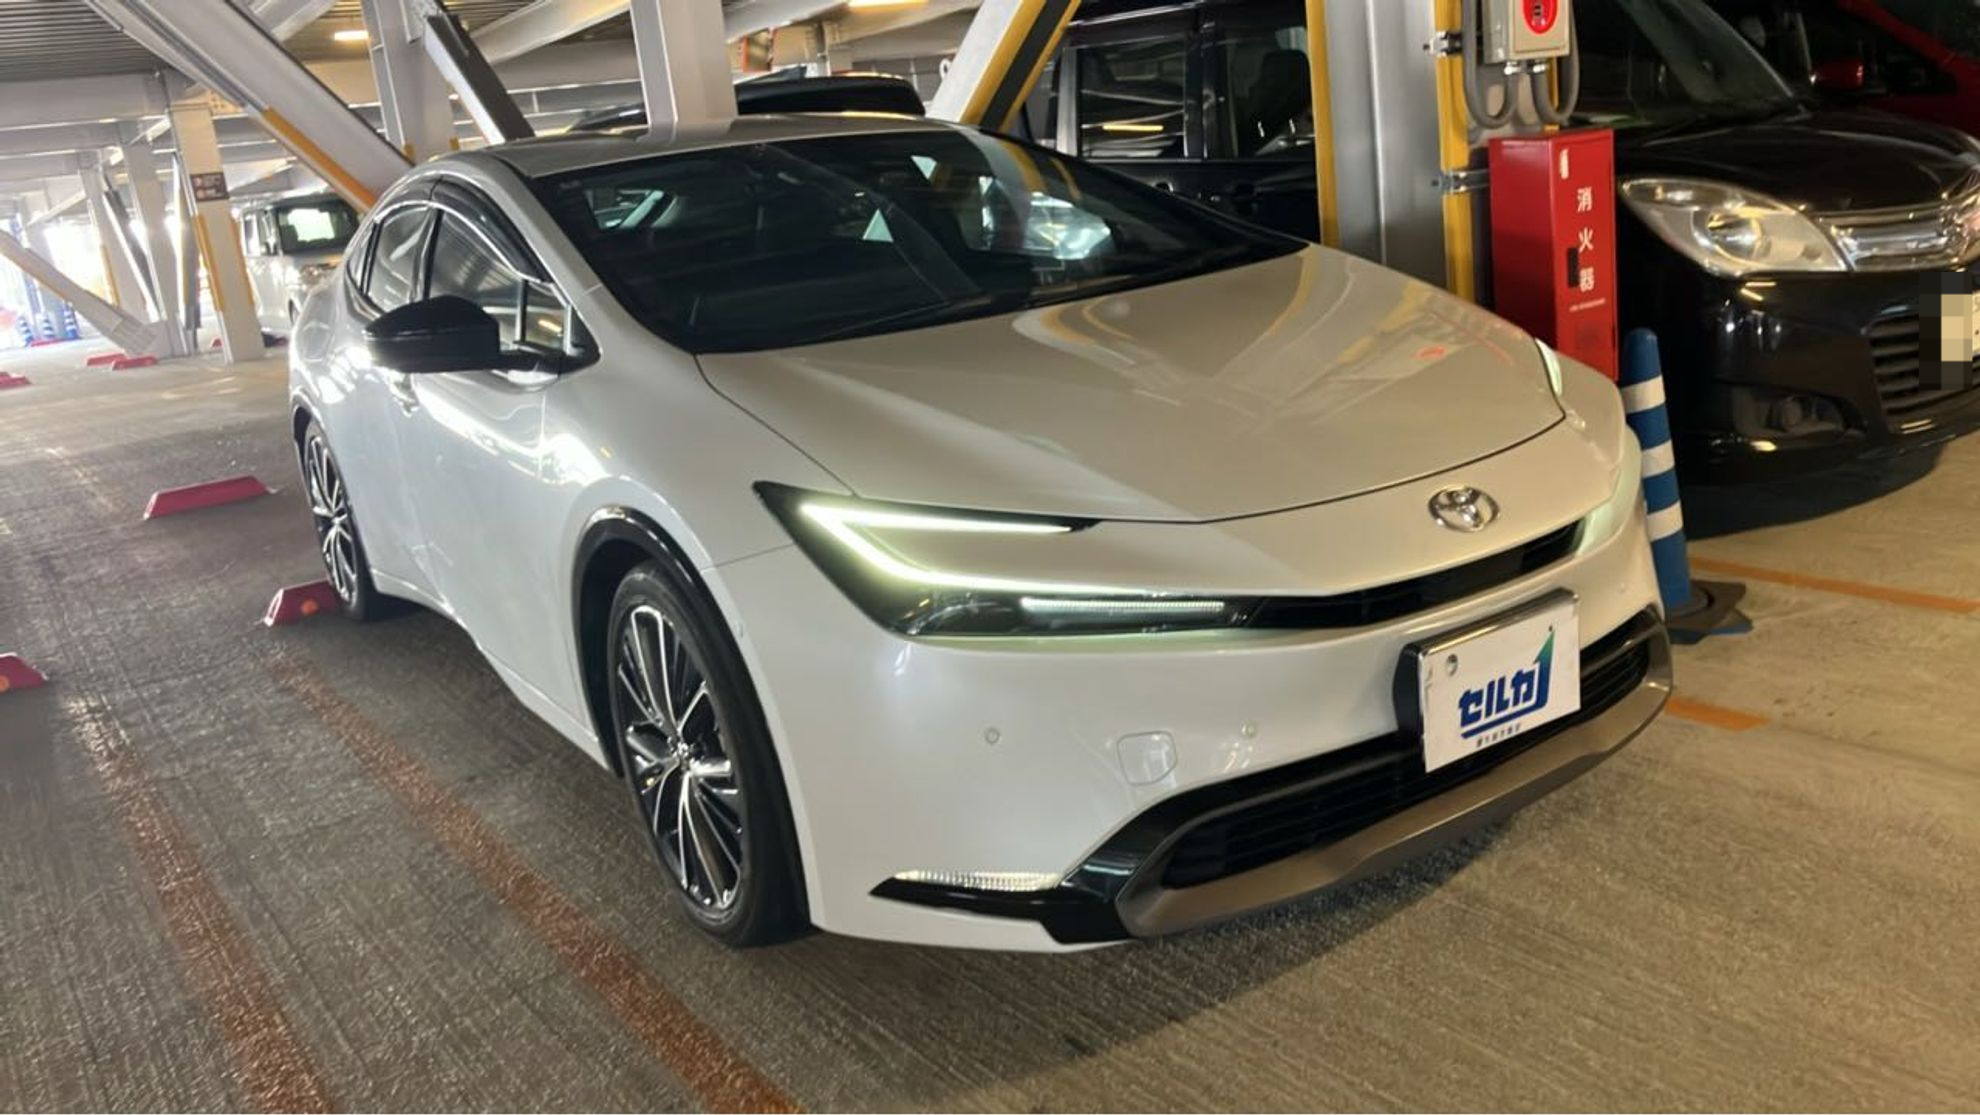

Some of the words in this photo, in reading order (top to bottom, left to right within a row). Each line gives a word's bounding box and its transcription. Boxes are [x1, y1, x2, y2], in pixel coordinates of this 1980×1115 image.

[1576, 186, 1595, 293] 消火器
[1458, 668, 1538, 729] セルカ
